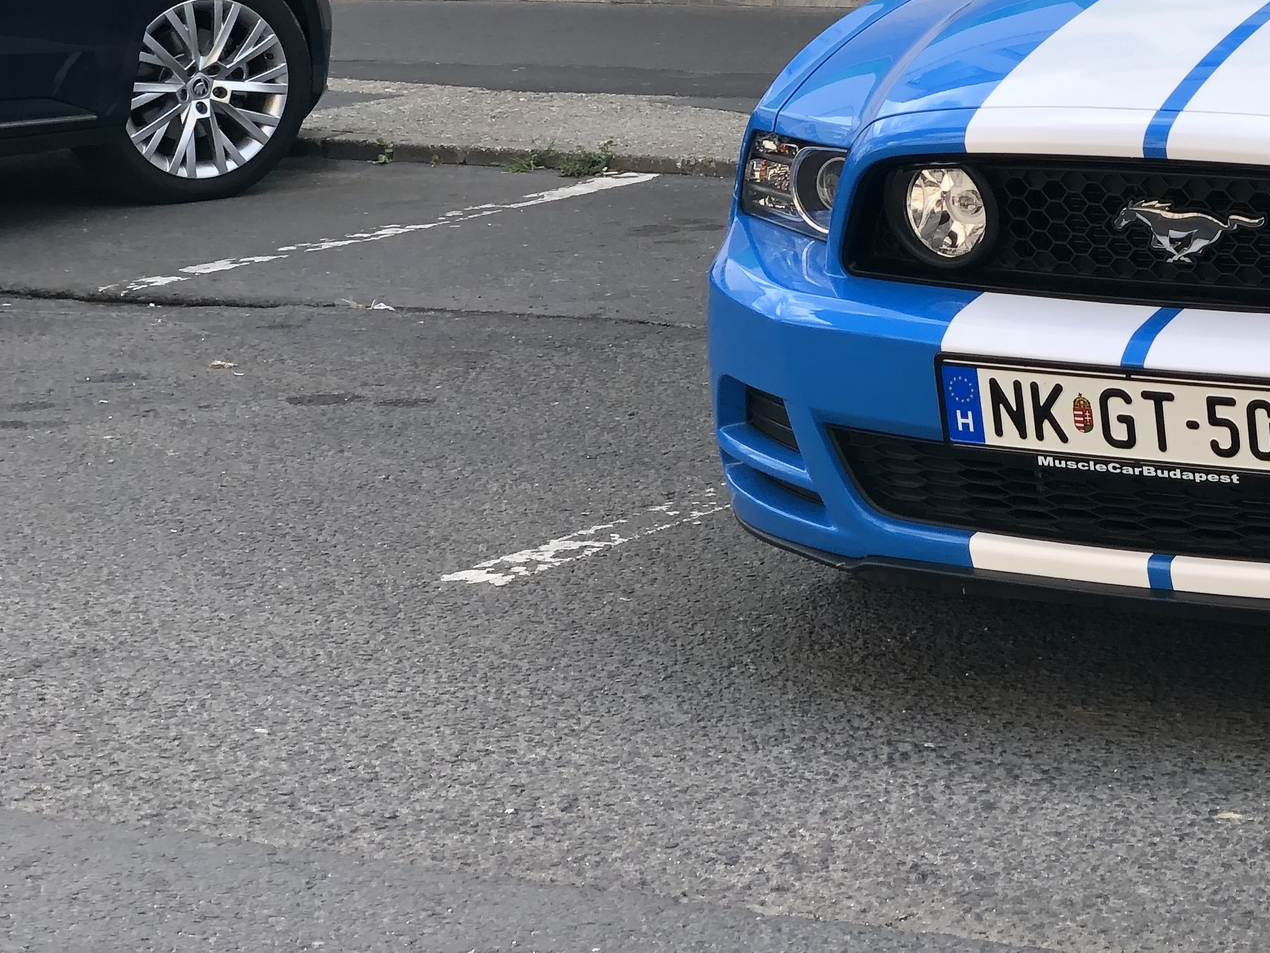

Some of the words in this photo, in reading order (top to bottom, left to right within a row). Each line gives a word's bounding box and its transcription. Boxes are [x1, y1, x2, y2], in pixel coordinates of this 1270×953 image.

[956, 409, 974, 432] H
[988, 377, 1069, 444] NK
[1037, 455, 1240, 484] MuscleCarBudapest
